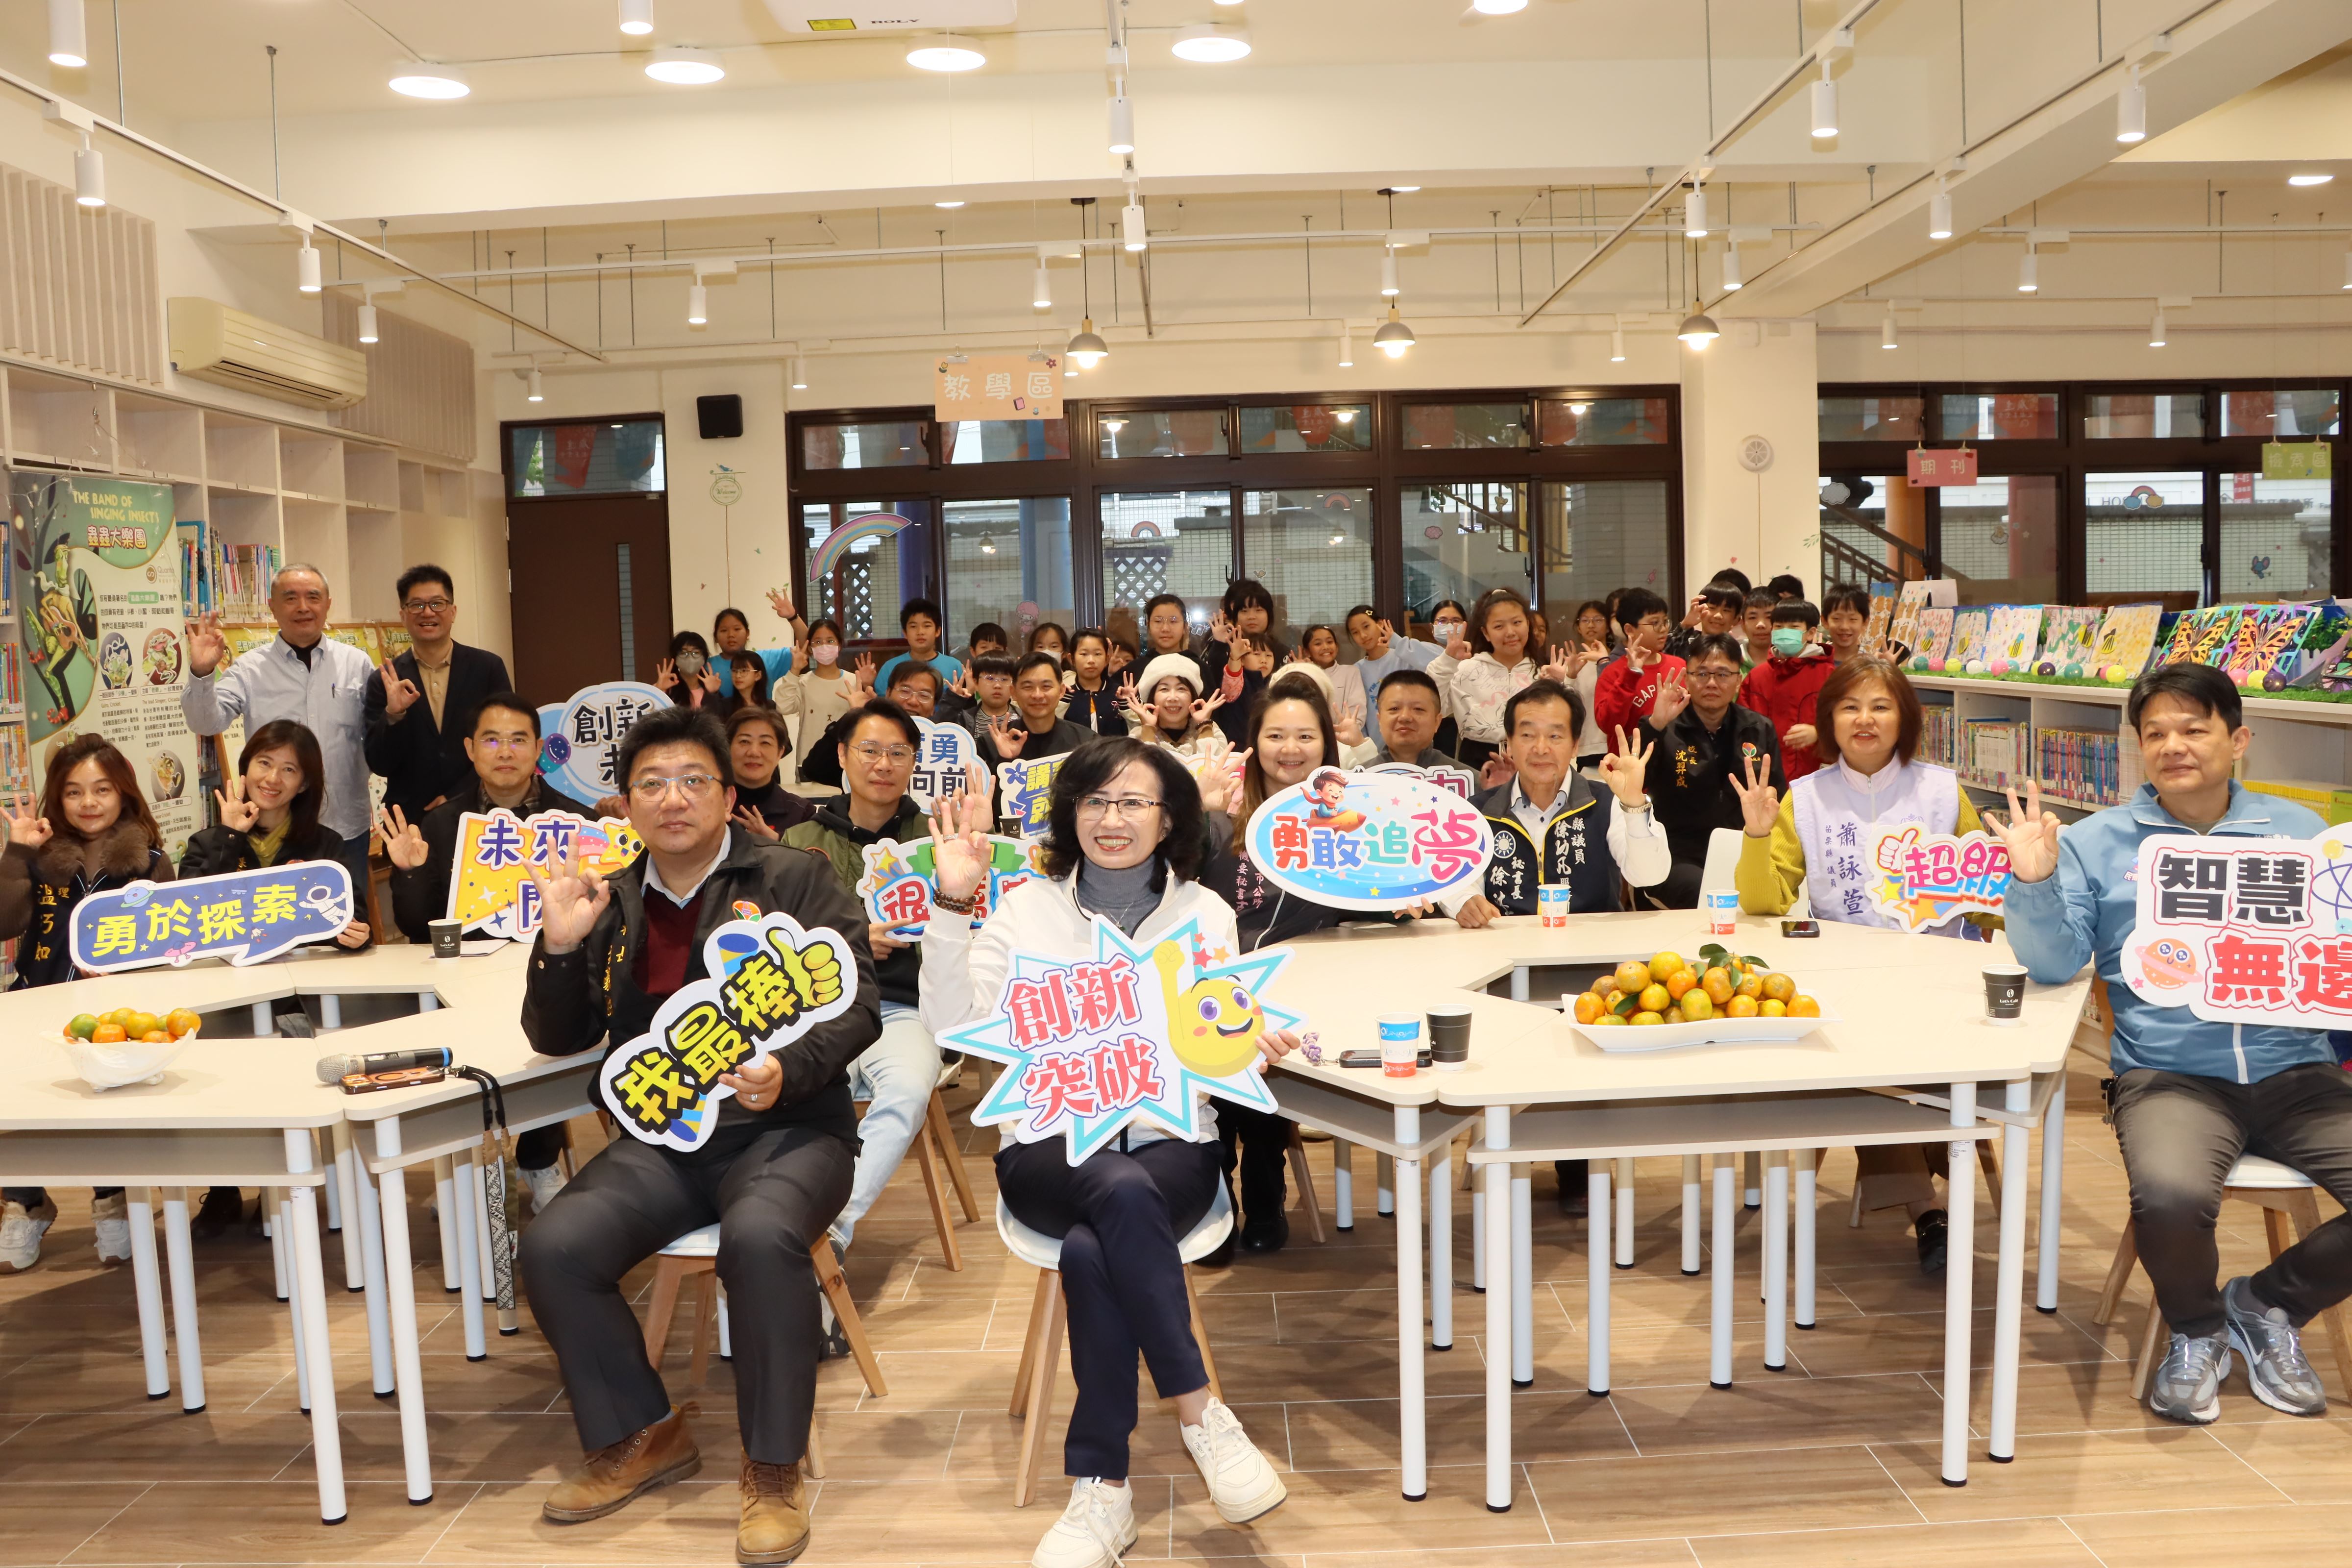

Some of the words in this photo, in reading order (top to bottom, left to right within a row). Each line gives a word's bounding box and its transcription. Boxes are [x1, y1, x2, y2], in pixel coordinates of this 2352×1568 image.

[944, 372, 1053, 400] 教學區
[1920, 459, 1965, 475] 期刊
[2268, 451, 2327, 468] 檢索區
[73, 491, 90, 505] THE
[92, 493, 118, 507] BAND
[121, 496, 133, 508] OF
[128, 510, 160, 523] INSECTS
[87, 525, 147, 549] 蟲蟲大樂團
[1632, 684, 1656, 708] GAP
[1688, 745, 1698, 765] 校長
[909, 765, 968, 798] 向前
[480, 819, 576, 866] 未來
[1273, 808, 1481, 881] 勇敢追夢
[1571, 817, 1586, 865] 縣議員
[1825, 825, 1834, 858] 苗栗縣
[1827, 865, 1837, 888] 議員
[1837, 822, 1863, 916] 蕭詠萱
[1905, 841, 2012, 898] 超級
[1252, 872, 1265, 909] 市公所
[2159, 854, 2306, 925] 智慧
[92, 884, 297, 957] 勇於探索
[1005, 958, 1137, 1047] 創新
[615, 955, 800, 1125] 我最棒
[1025, 1038, 1161, 1127] 突破
